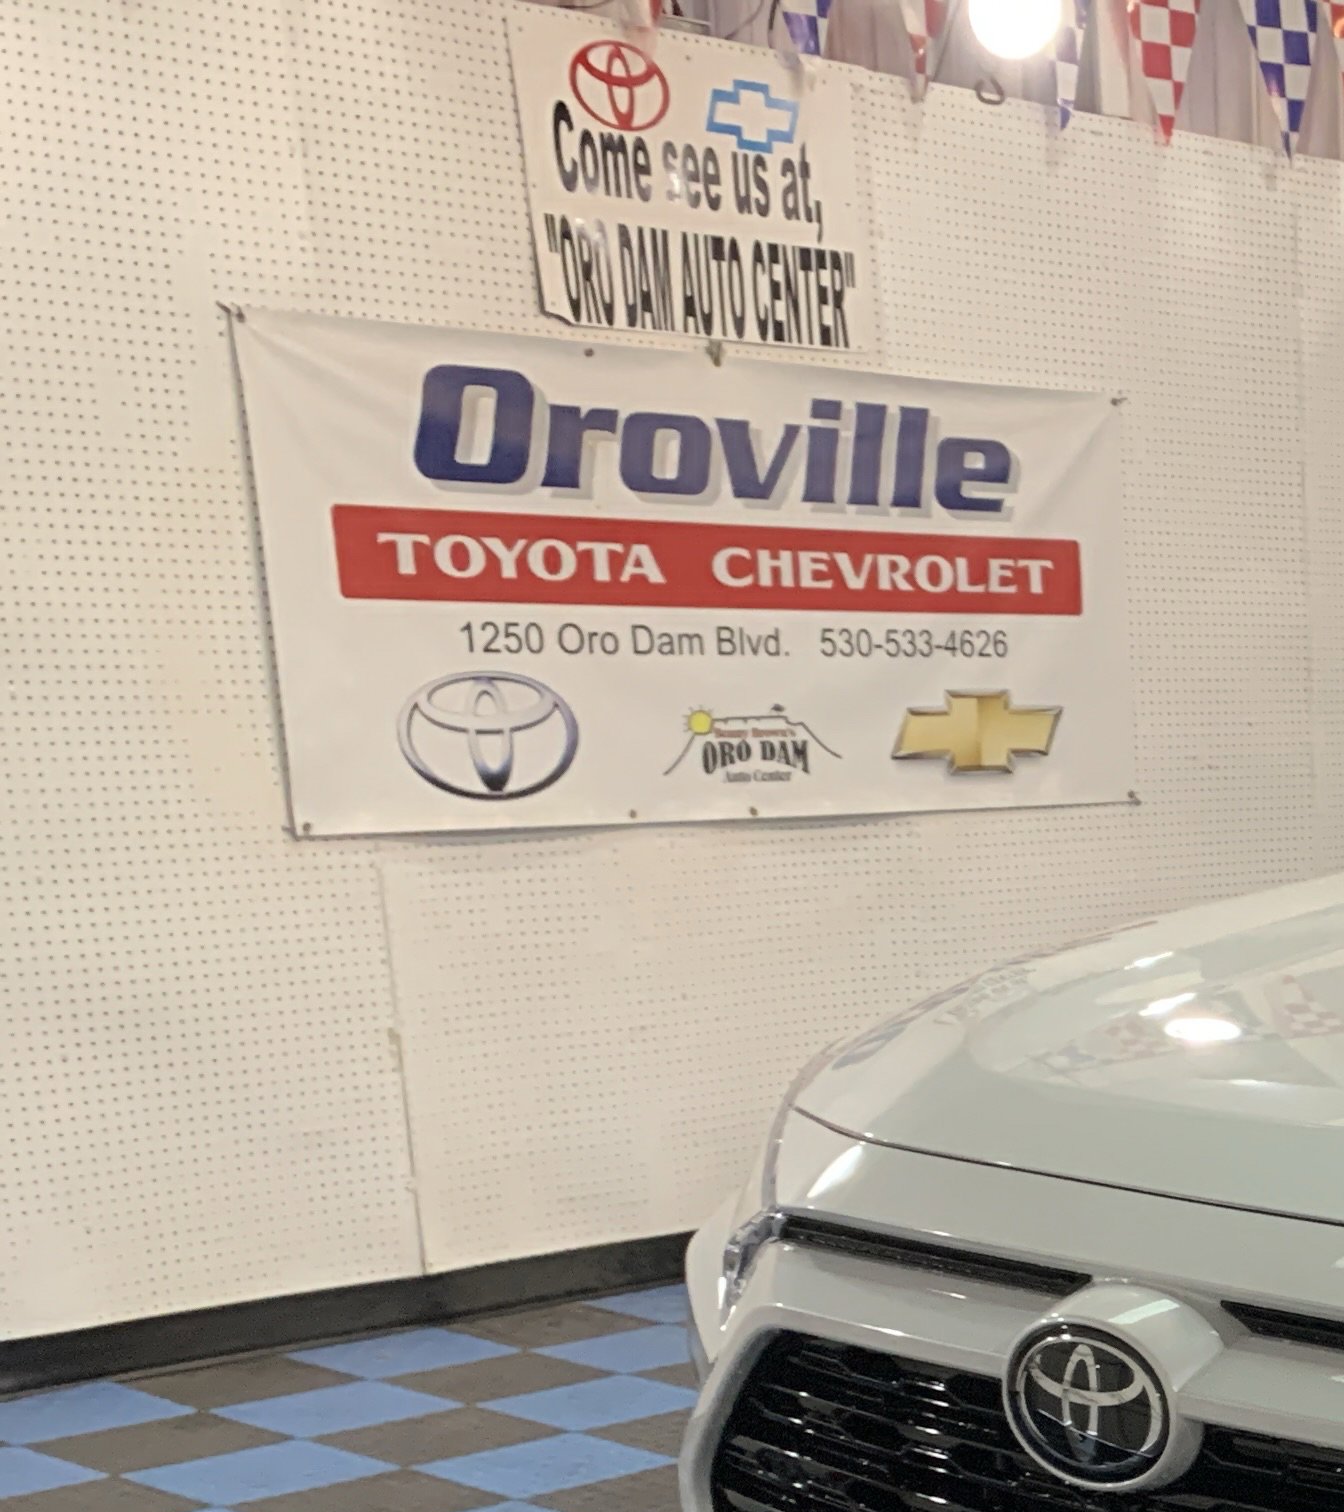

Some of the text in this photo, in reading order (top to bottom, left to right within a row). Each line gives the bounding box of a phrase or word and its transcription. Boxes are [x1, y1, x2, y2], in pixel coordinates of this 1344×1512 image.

[552, 100, 823, 243] Come see us at,
[544, 213, 857, 349] "ORO DAM AUTO CENTER"
[412, 363, 1014, 514] Oroville
[377, 532, 1054, 595] TOYOTA CHEVROLET
[459, 621, 1009, 659] 1250 Oro Dam Blvd. 530-533-4626
[702, 740, 810, 775] ORO DAM
